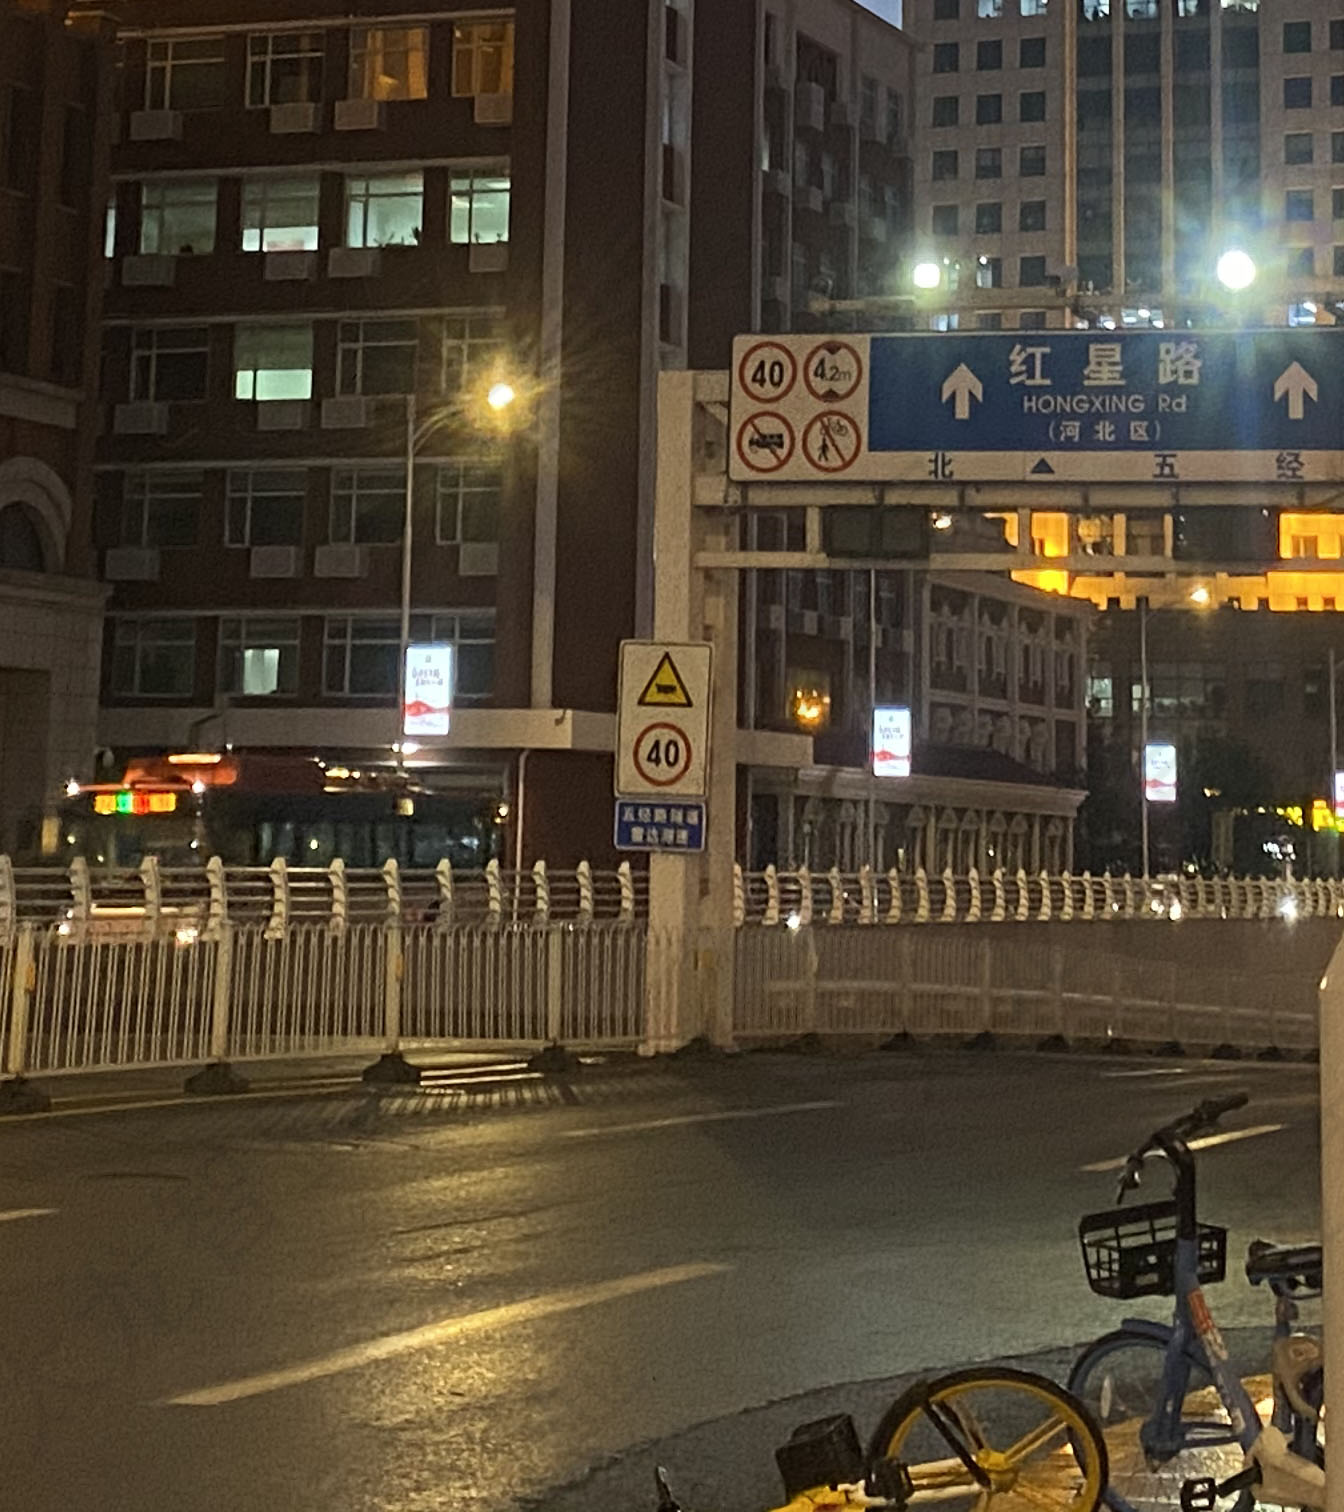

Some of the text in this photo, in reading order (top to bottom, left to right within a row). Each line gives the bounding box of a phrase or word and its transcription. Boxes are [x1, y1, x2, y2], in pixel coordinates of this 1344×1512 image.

[751, 359, 784, 388] 40
[813, 357, 852, 382] 4.2m
[1009, 341, 1203, 386] 红星路
[1023, 393, 1188, 414] HONGXING Rd
[927, 451, 954, 480] 北
[646, 739, 679, 768] 40
